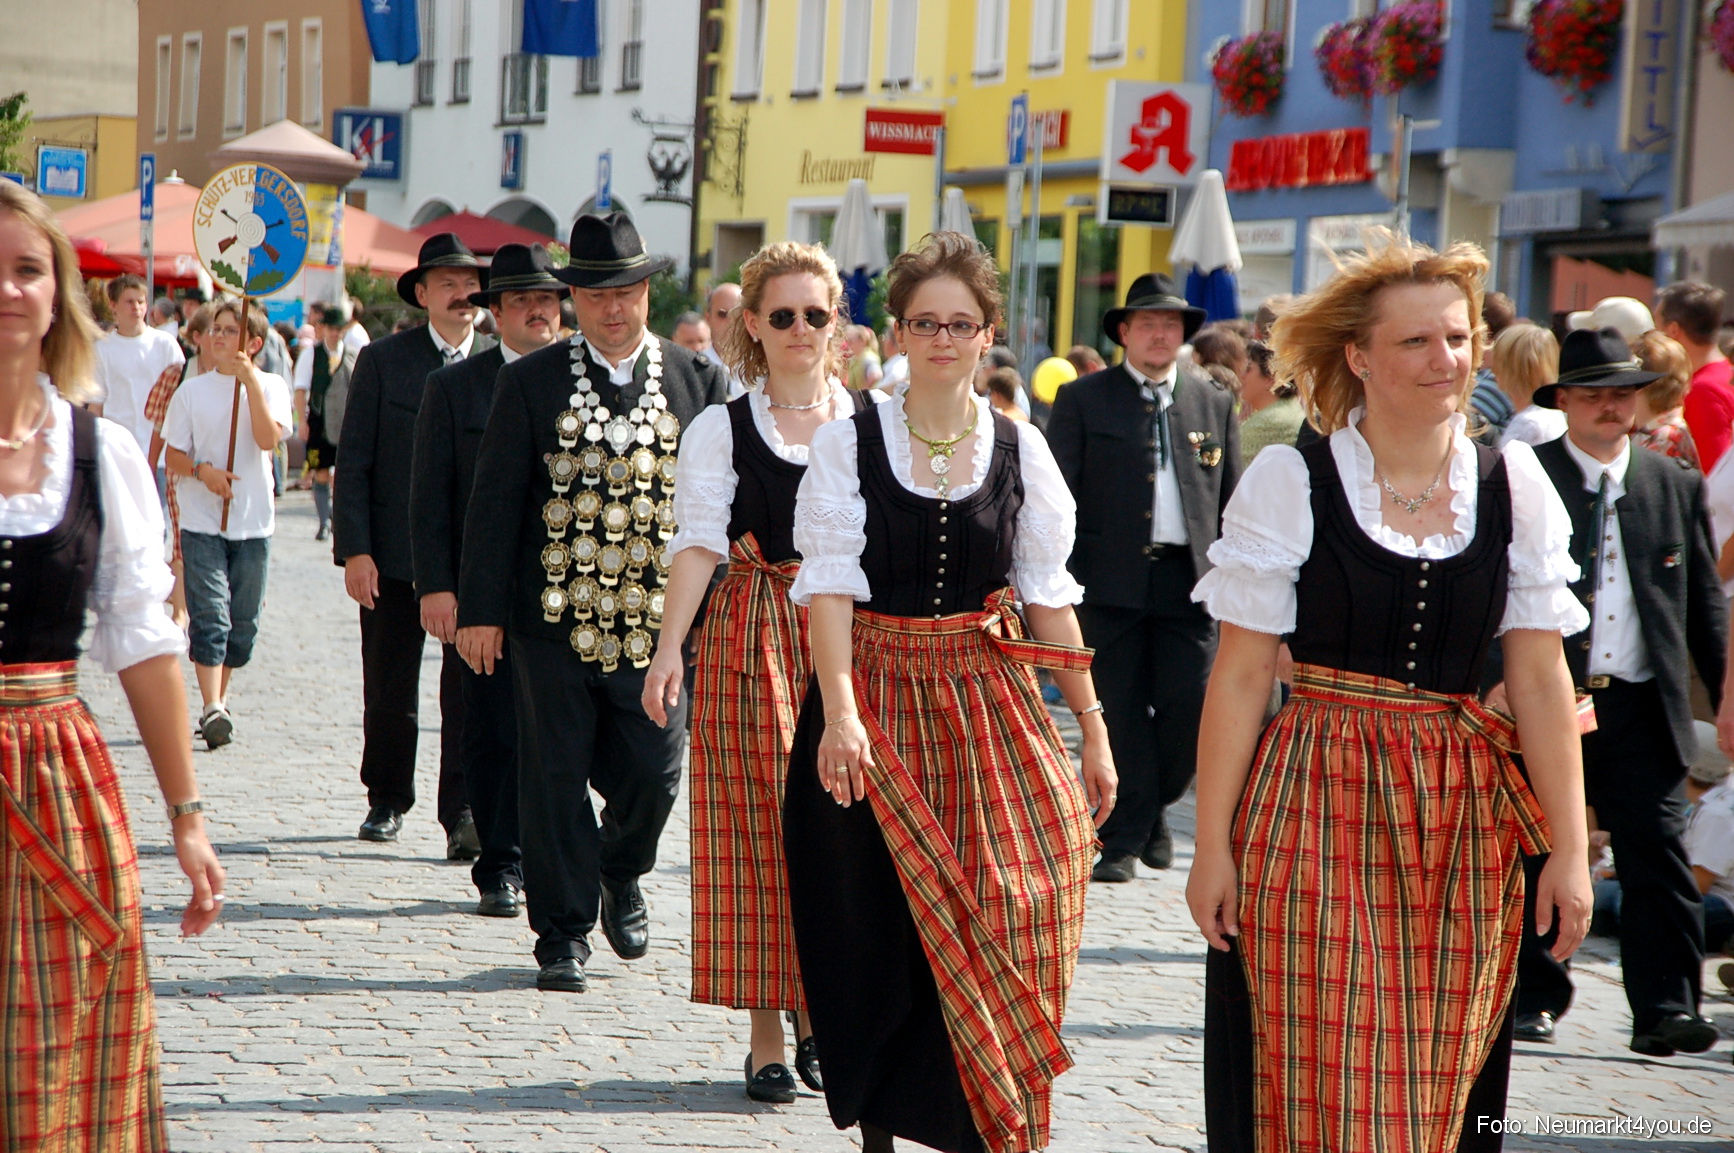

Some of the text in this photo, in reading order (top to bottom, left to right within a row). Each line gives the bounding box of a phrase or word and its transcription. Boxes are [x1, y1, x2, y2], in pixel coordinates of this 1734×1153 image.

[1012, 103, 1025, 157] P
[142, 158, 153, 199] P
[800, 149, 876, 184] Restaurant
[260, 170, 306, 240] GERSDORF
